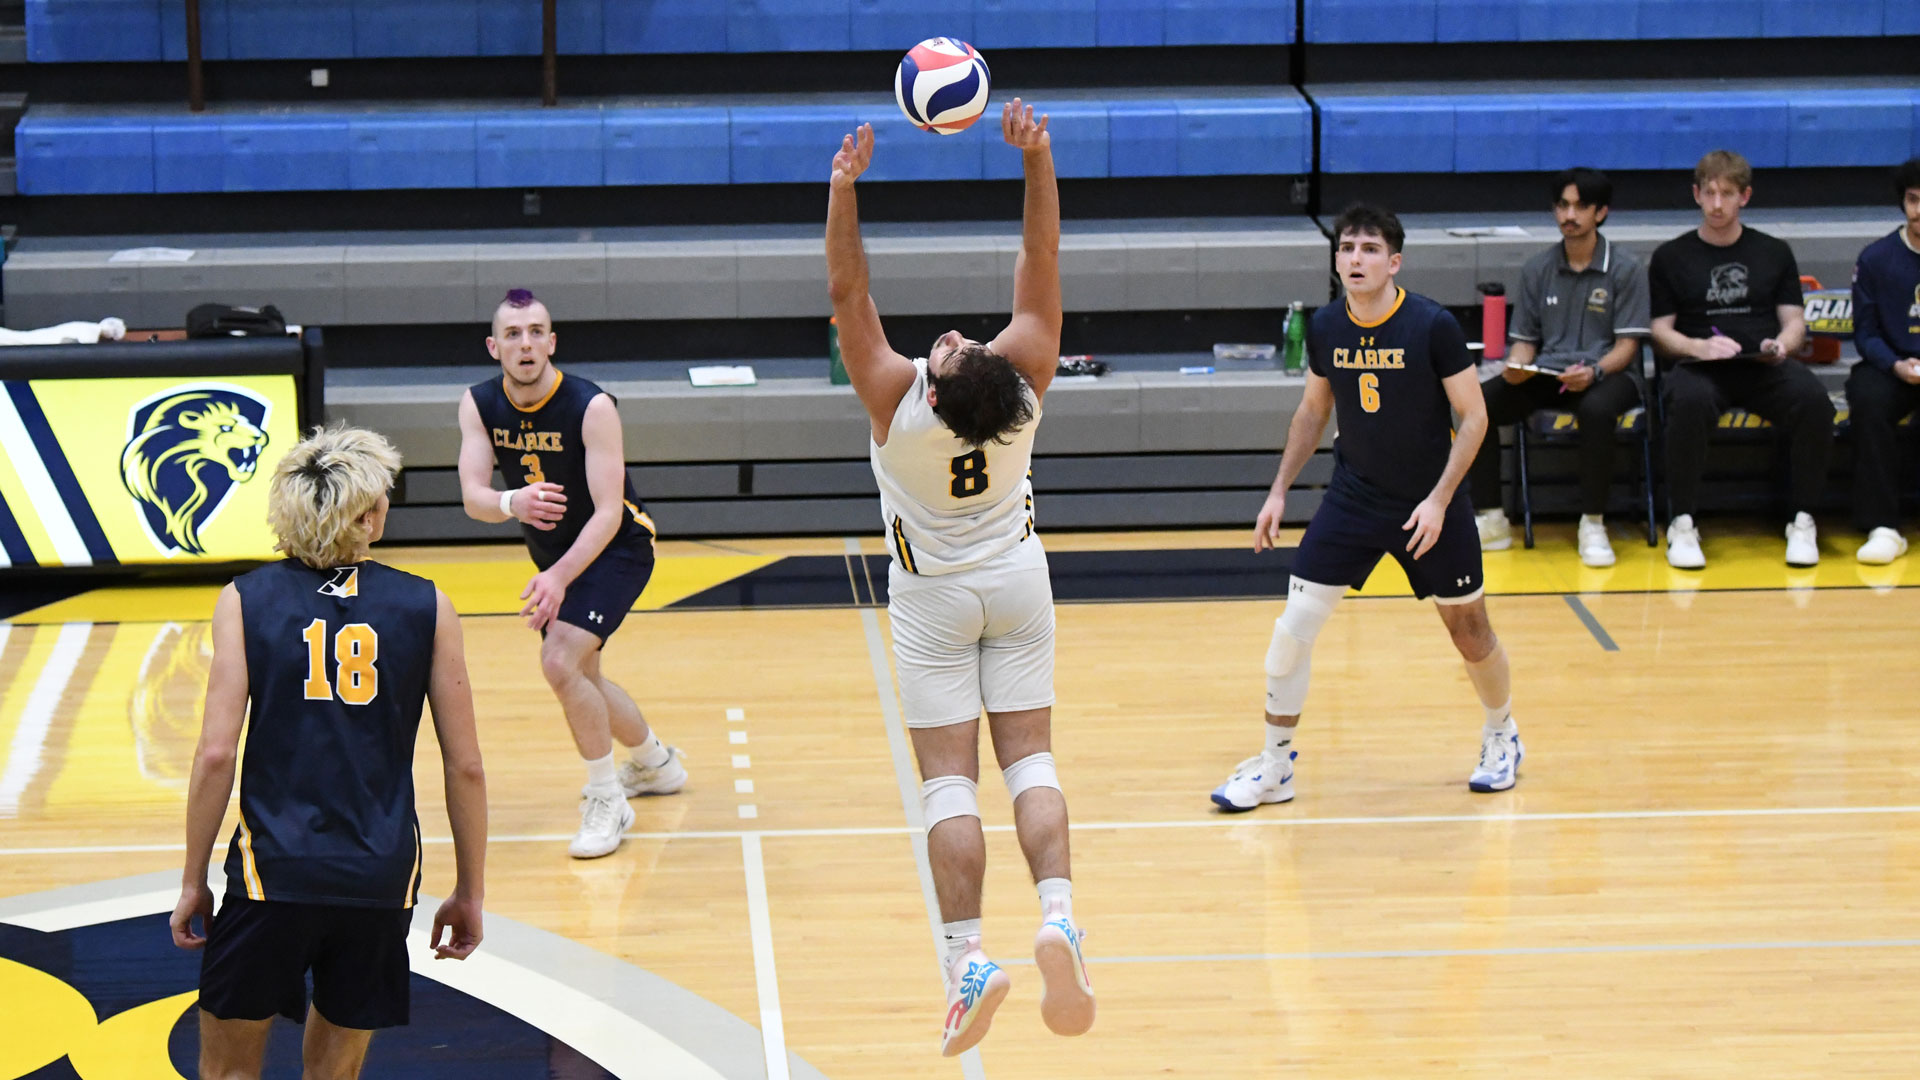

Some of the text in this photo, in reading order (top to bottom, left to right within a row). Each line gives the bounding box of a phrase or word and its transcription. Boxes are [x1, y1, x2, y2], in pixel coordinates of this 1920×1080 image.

[1333, 347, 1405, 369] CLARKE
[1358, 372, 1380, 413] 6
[493, 428, 564, 452] CLARKE
[520, 453, 546, 485] 3
[949, 448, 991, 499] 8
[302, 618, 378, 705] 18
